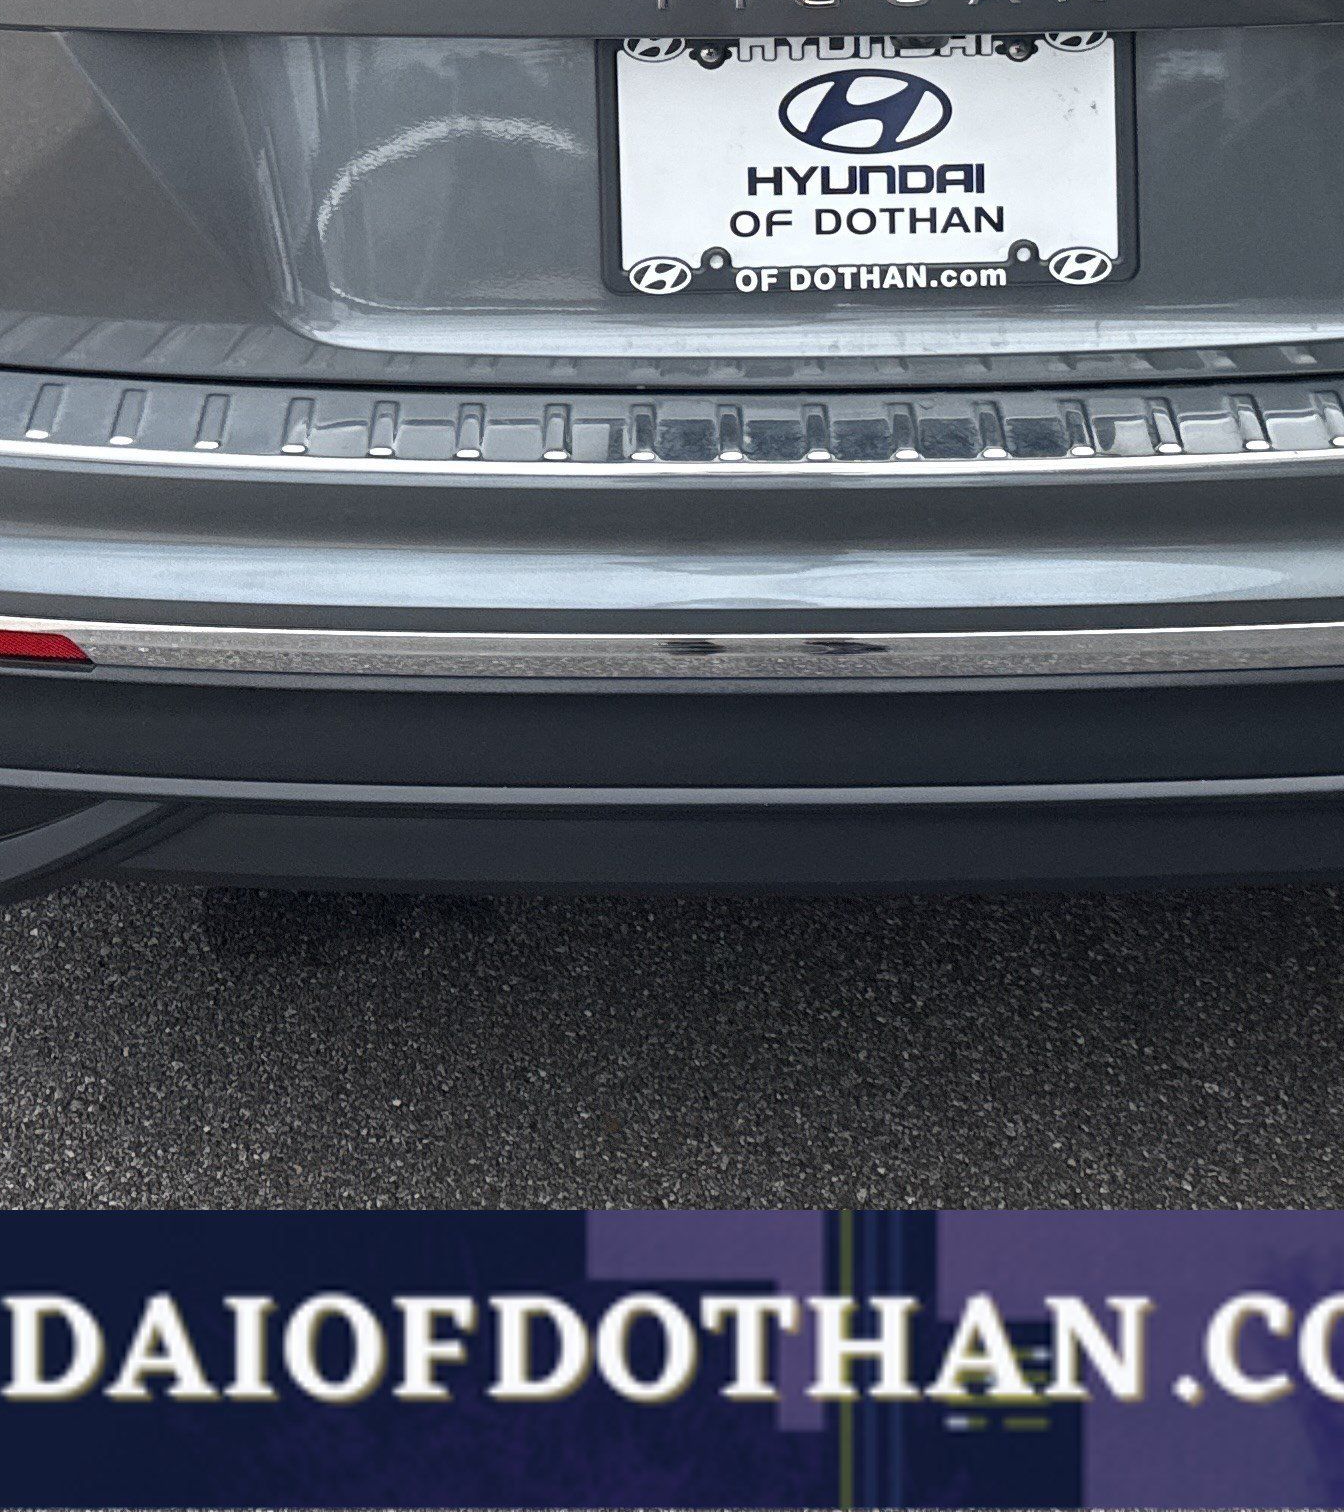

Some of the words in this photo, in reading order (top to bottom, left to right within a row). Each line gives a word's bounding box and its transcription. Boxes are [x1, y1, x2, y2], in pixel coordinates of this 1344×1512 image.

[738, 35, 994, 62] HYUNAI
[747, 163, 985, 196] HYUNDAI
[729, 209, 793, 238] OF
[814, 205, 1004, 235] DOTHAN
[735, 268, 778, 293] OF
[789, 264, 1007, 292] DOTHAN.com
